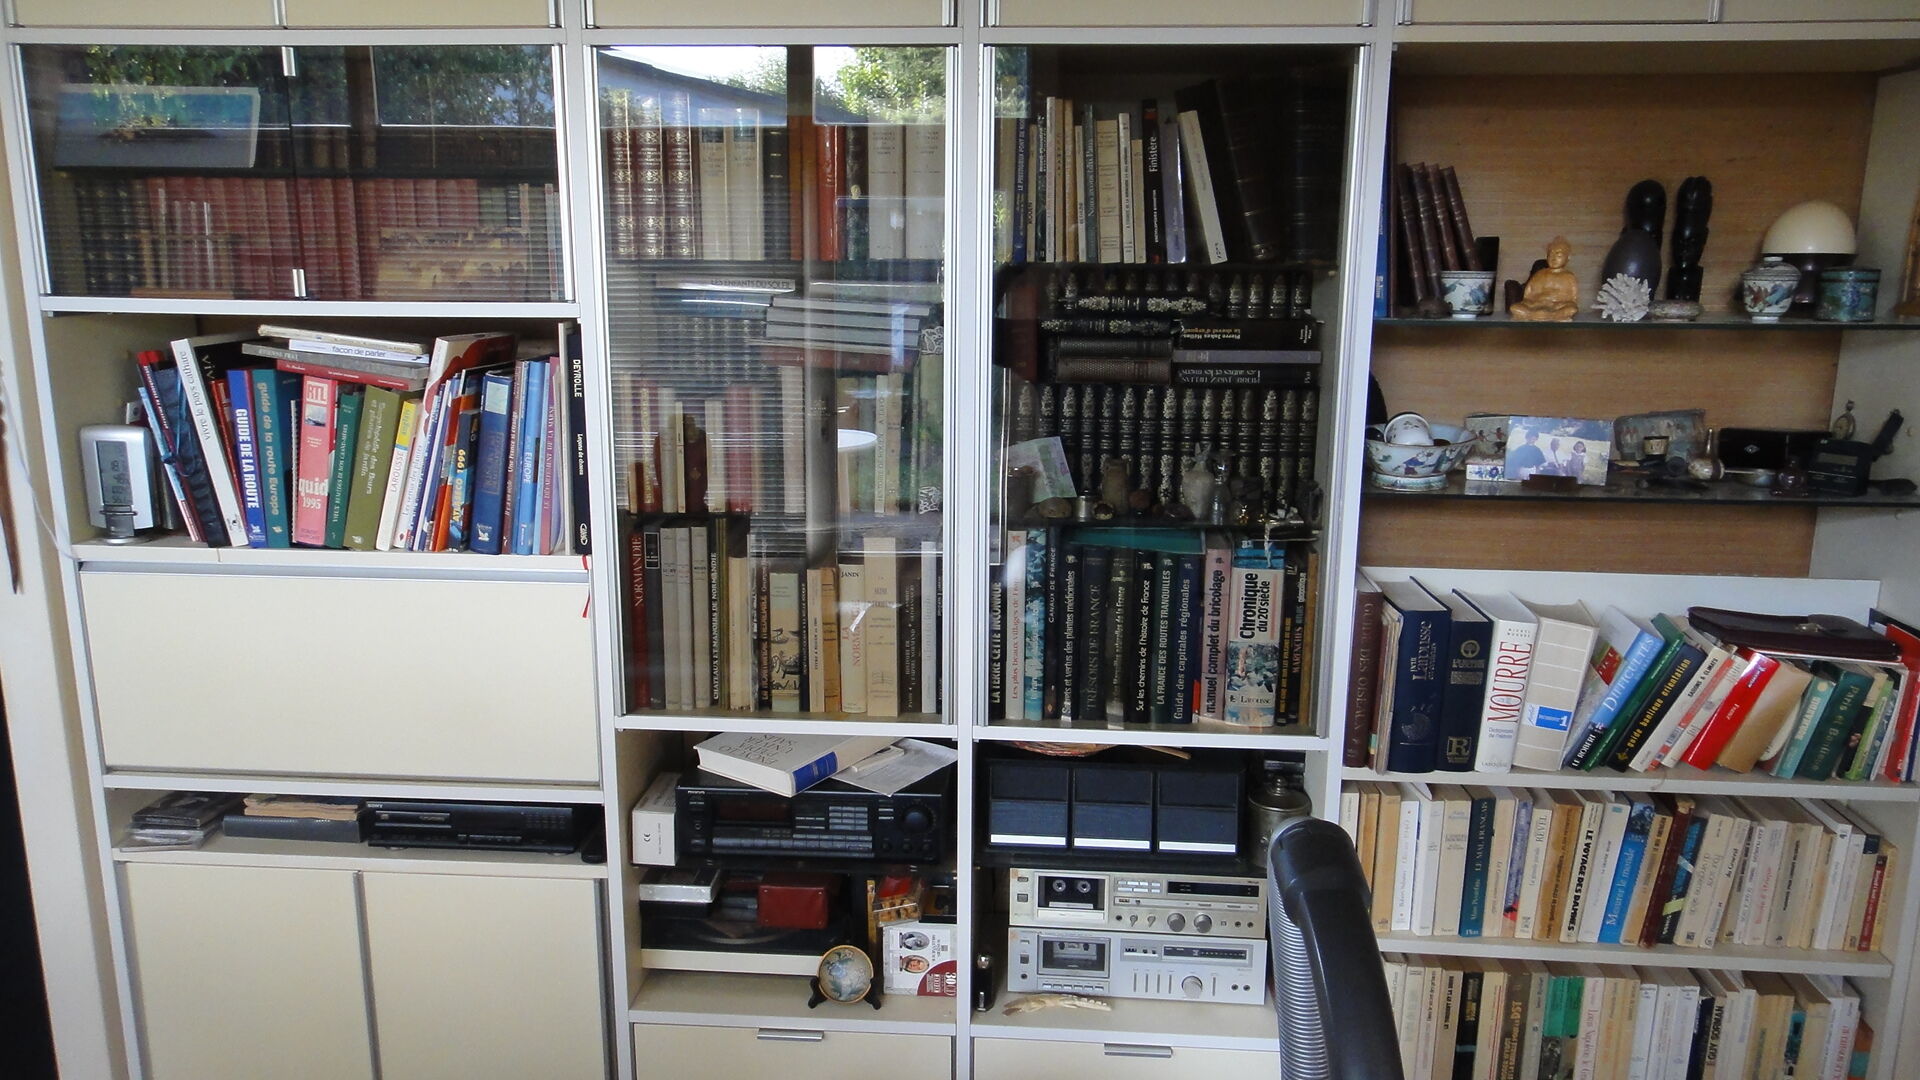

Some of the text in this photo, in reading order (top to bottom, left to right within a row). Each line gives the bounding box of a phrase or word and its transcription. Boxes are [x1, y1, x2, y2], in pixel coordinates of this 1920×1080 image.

[1148, 136, 1158, 172] Finistère
[365, 349, 387, 358] parler
[573, 359, 582, 398] DEYROLLE
[235, 409, 259, 508] GUIDE DE LA ROUTE
[256, 382, 280, 515] guide de la route Europe
[455, 448, 466, 474] 1999
[389, 451, 405, 493] LAROUSSE
[523, 451, 533, 483] EUROPE
[298, 477, 329, 497] quid
[302, 497, 322, 510] 1995
[631, 536, 645, 607] NORMANDIE
[1066, 570, 1076, 612] médicinales
[1258, 580, 1270, 607] siècle
[711, 600, 718, 611] DE
[1238, 572, 1259, 639] Chronique
[842, 627, 850, 640] LA
[1011, 612, 1021, 641] villages
[1065, 612, 1075, 639] plantes
[1156, 570, 1172, 705] LA FRANCE DES ROUTES TRANQUILLES
[1256, 621, 1268, 632] du
[712, 648, 719, 658] ET
[991, 581, 1002, 704] LA TERRE CETTE INCONNUE
[1011, 641, 1020, 666] beaux
[1064, 641, 1073, 653] des
[1084, 584, 1100, 710] TRÉSORS DE FRANCE
[1135, 580, 1150, 711] Sur les chemins de l'histoire de France
[1173, 579, 1191, 719] Guide des capitales régionales
[1205, 569, 1225, 713] manuel complet du bricolage
[1011, 667, 1021, 685] plus
[1064, 655, 1072, 678] vertus
[1353, 603, 1374, 730] GUIDE DES OISEAUX
[1011, 686, 1019, 699] Les
[1487, 641, 1533, 724] MOURRE
[1627, 657, 1692, 748] guide banlieue orientation
[1839, 685, 1860, 711] Paris
[1559, 715, 1568, 727] 1
[1833, 714, 1844, 725] et
[1577, 734, 1596, 760] ROBERT
[1535, 815, 1547, 842] REVEL
[1586, 829, 1595, 840] LE
[1476, 841, 1484, 859] MAL
[1578, 842, 1592, 877] VOYAGE
[1619, 848, 1635, 878] monde
[1474, 862, 1482, 871] LE
[1575, 876, 1585, 894] DES
[1616, 879, 1625, 888] le
[1606, 889, 1625, 926] Mesurer
[946, 972, 957, 985] 30
[1708, 1005, 1724, 1061] GUY SORMAN
